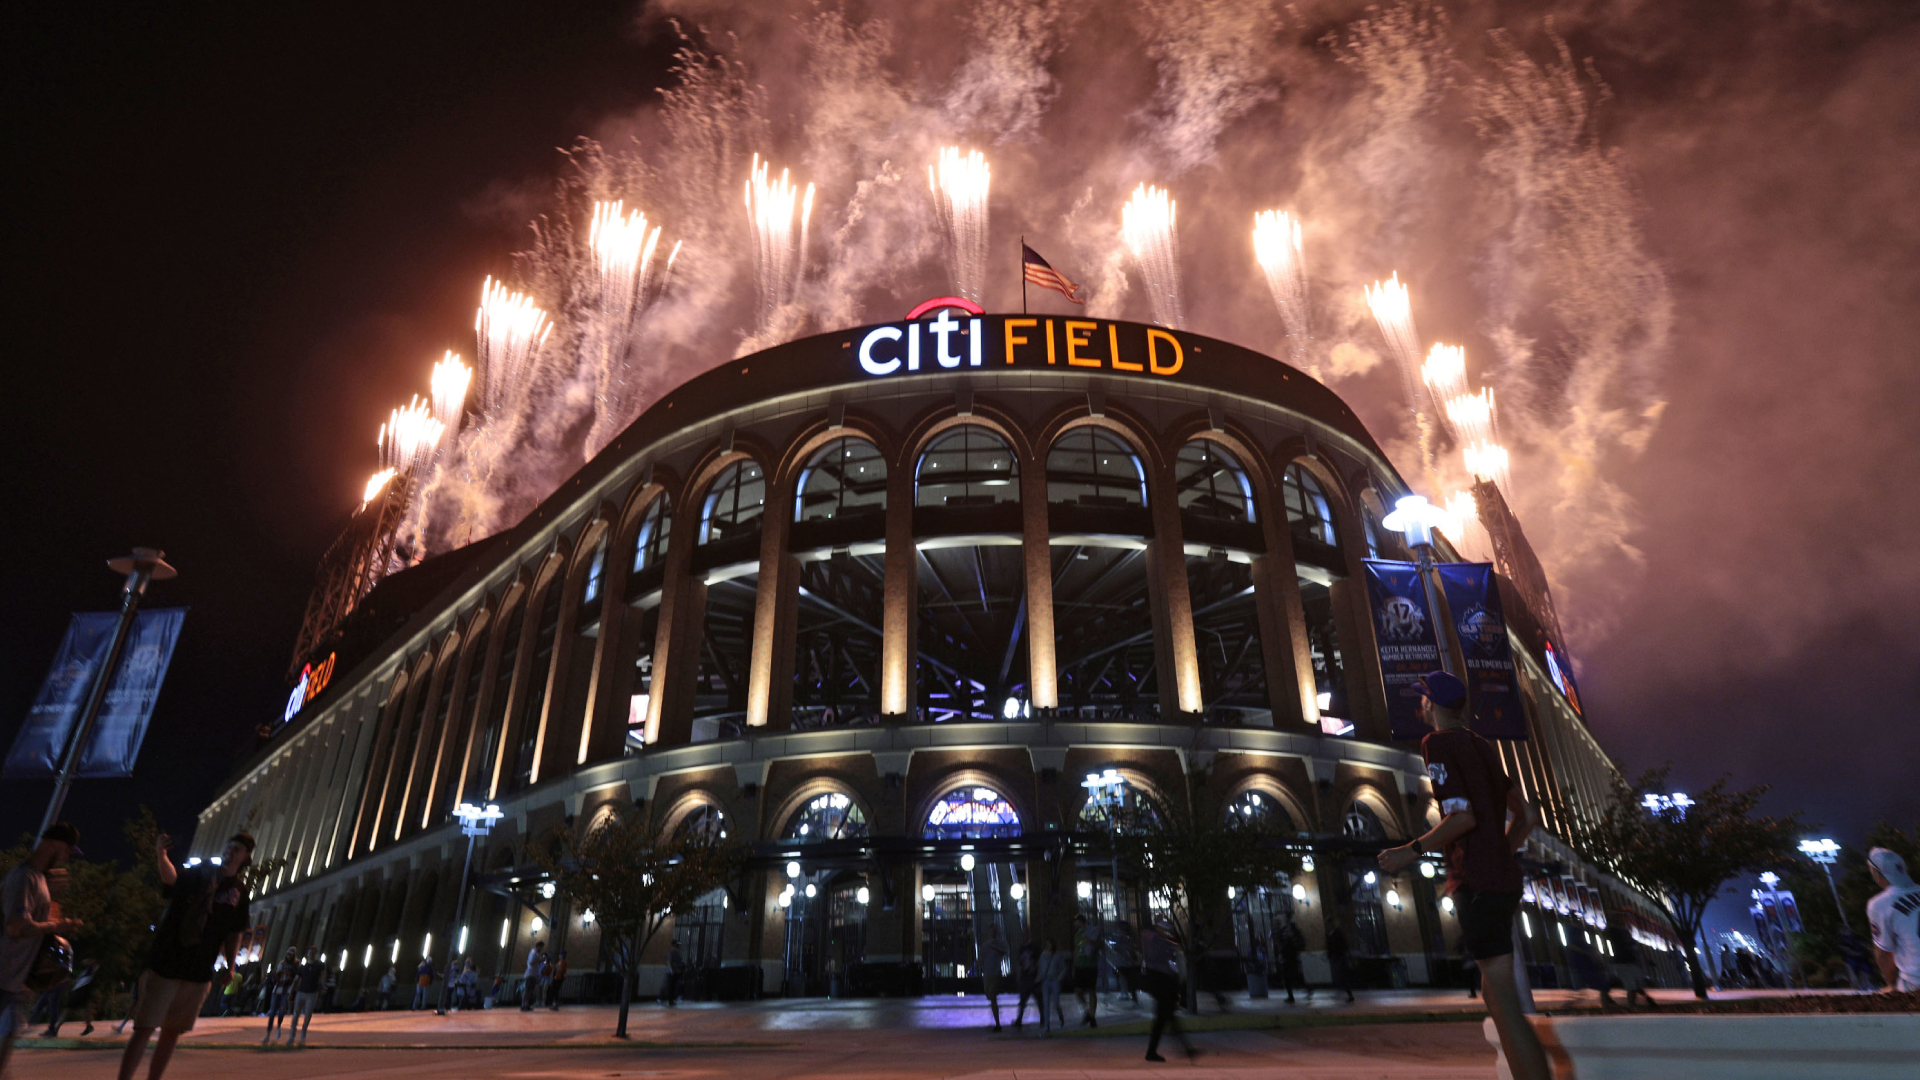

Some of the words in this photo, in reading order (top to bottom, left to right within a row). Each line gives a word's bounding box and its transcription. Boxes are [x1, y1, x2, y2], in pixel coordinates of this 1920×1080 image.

[858, 308, 983, 376] citi
[1004, 318, 1185, 376] FIELD
[1394, 603, 1410, 620] 17
[1380, 645, 1399, 653] KEITH
[1400, 645, 1437, 653] HERNANDEZ
[1382, 653, 1404, 661] NUMBER
[1405, 653, 1438, 661] RETIREMENT
[1467, 659, 1480, 668] OLD
